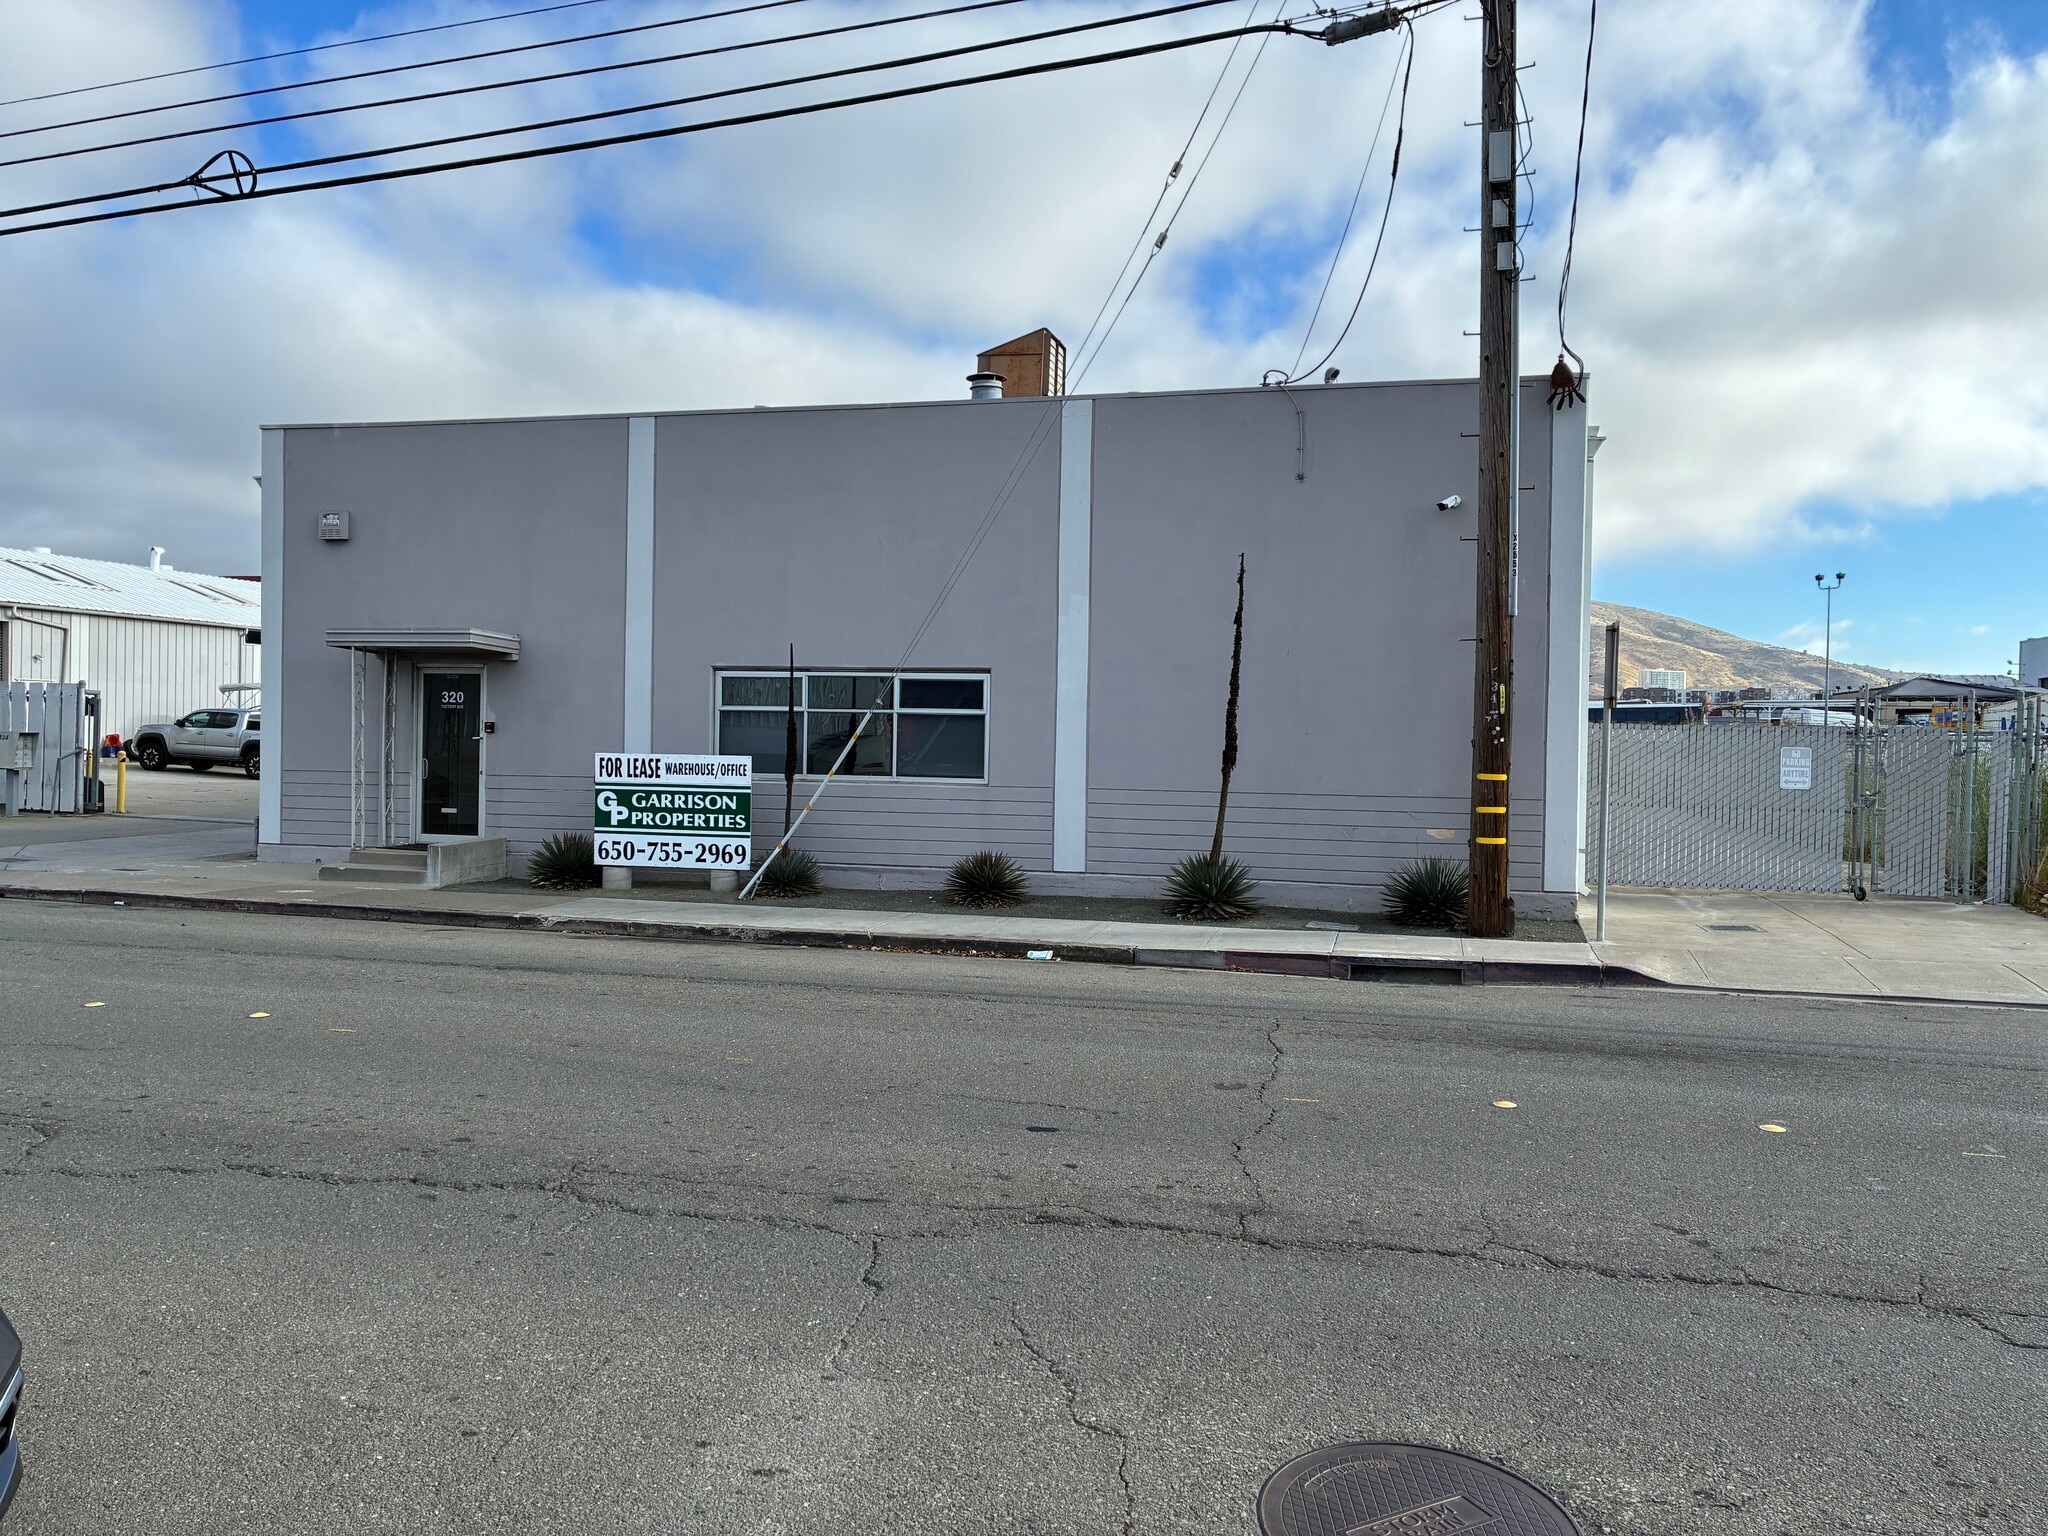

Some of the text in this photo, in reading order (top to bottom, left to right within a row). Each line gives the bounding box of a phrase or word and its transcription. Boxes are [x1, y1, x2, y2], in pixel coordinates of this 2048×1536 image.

[441, 691, 464, 703] 320
[1782, 758, 1810, 766] PARKING
[1791, 750, 1801, 758] NO
[599, 757, 748, 779] FOR LEASE WAREHOUSE/OFFICE
[1782, 769, 1809, 778] ANYTIME
[597, 791, 629, 825] GP
[631, 792, 737, 810] GARRISON
[631, 811, 747, 828] PROPERTIES
[598, 840, 747, 864] 650-755-2969
[1363, 1460, 1388, 1468] USA
[1370, 1504, 1458, 1536] STORM
